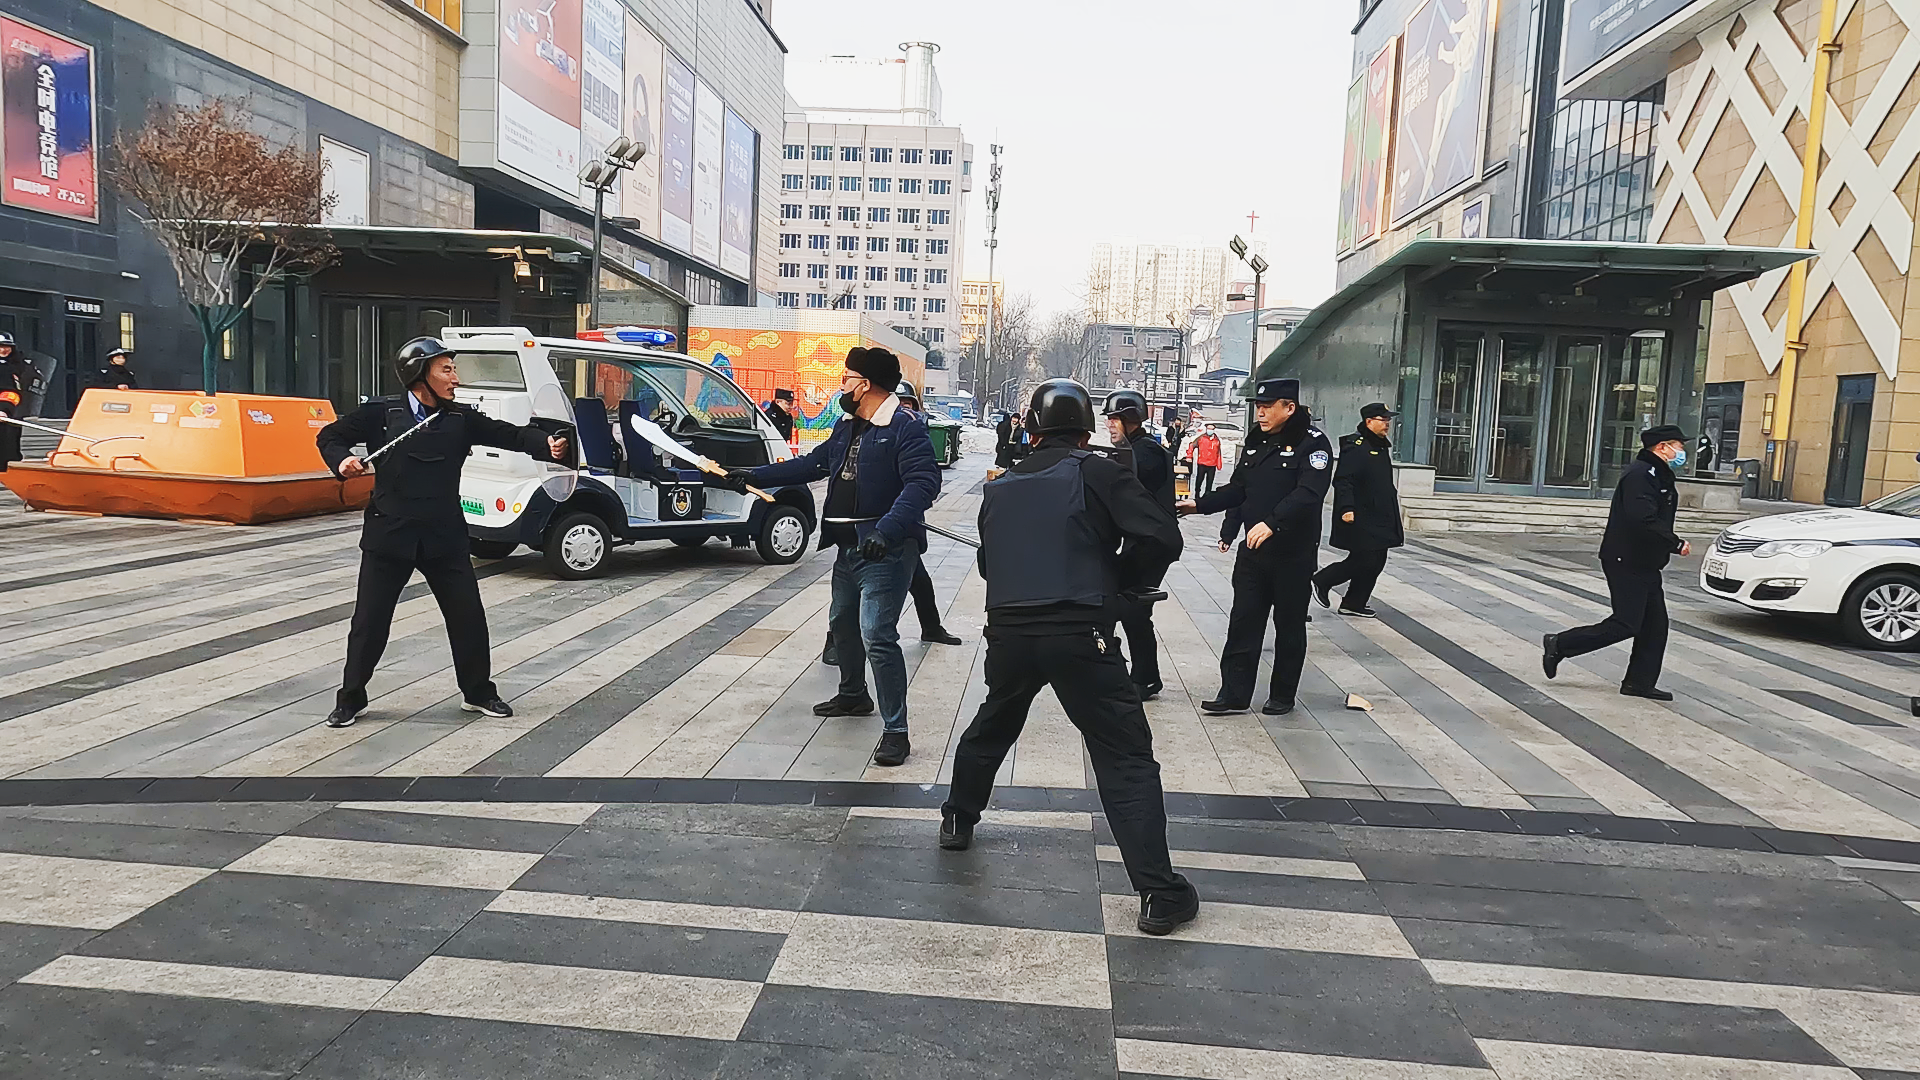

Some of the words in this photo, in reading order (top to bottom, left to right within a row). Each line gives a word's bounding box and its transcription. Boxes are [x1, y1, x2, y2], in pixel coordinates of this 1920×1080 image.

[37, 64, 58, 180] 全时电竞馆
